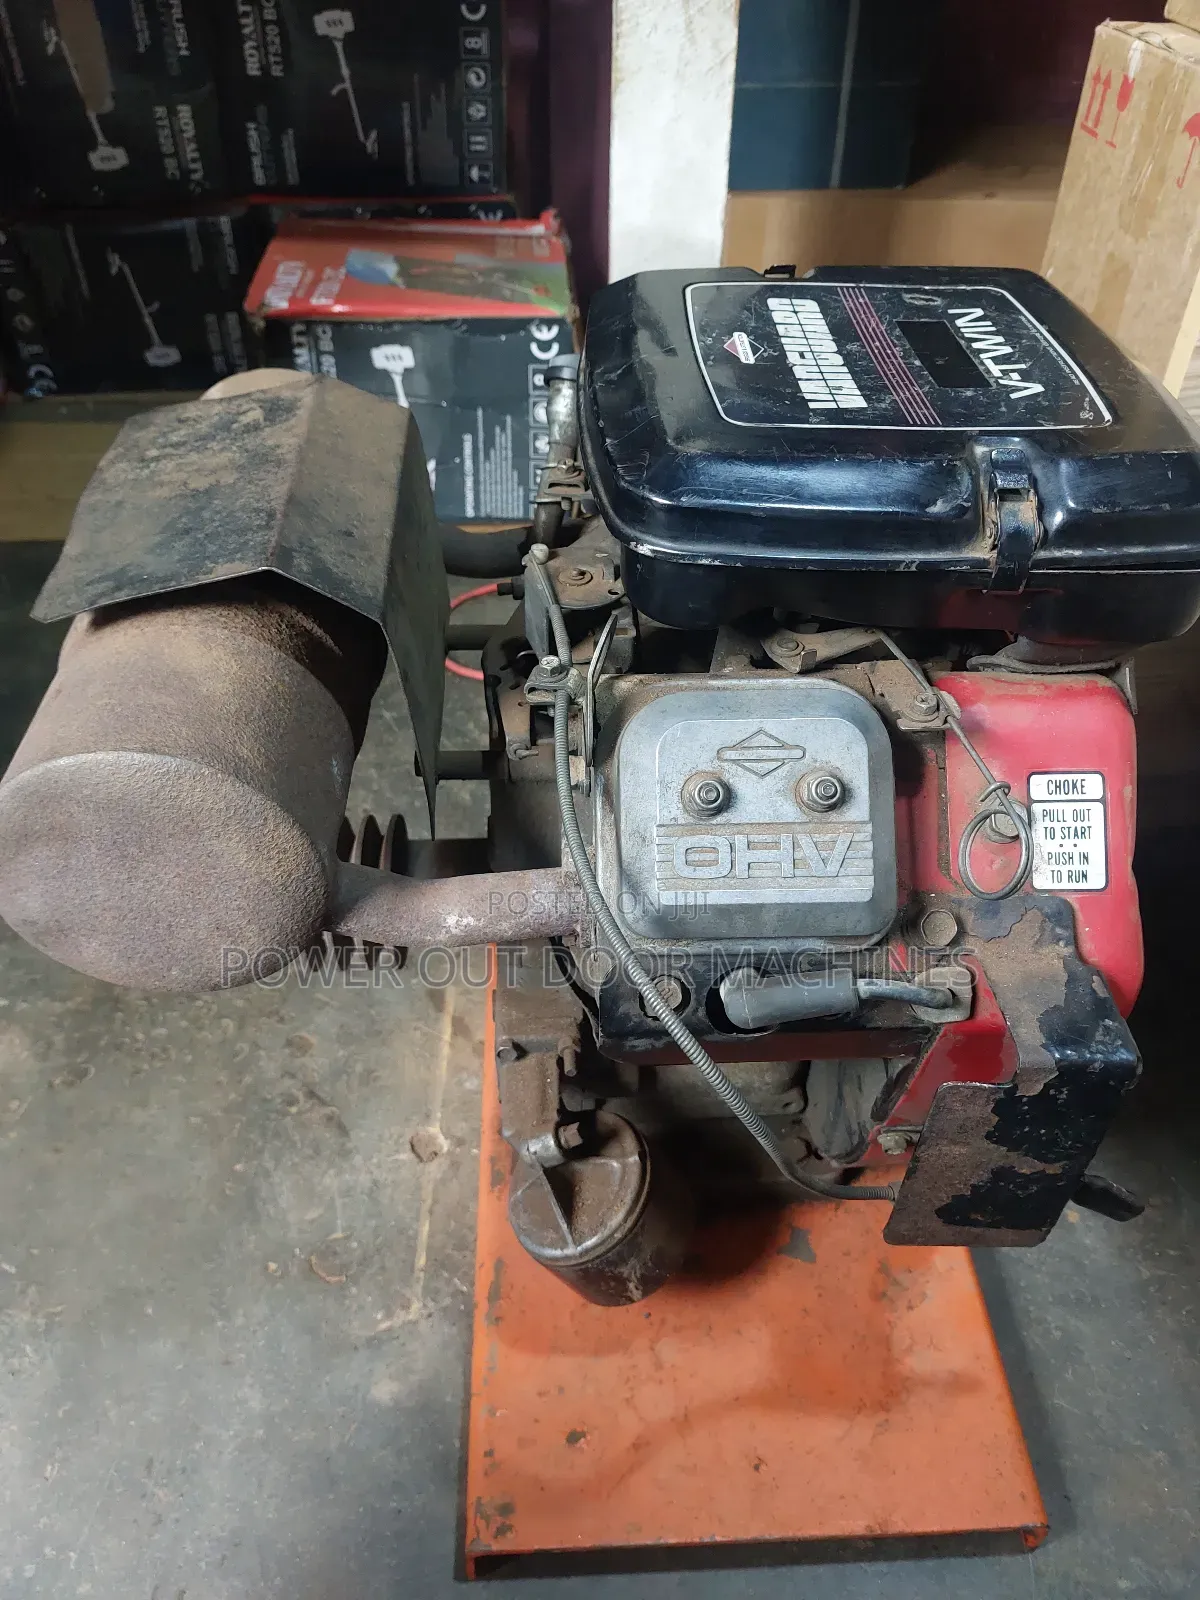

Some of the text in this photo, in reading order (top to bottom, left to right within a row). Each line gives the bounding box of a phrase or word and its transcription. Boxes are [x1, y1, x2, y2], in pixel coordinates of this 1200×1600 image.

[237, 0, 263, 76] ROYALT
[766, 297, 869, 409] VANGUARD
[947, 308, 1046, 400] V-TWIN
[1047, 778, 1087, 795] CHOKE
[1042, 808, 1092, 823] PULL OUT
[1043, 826, 1092, 840] TO START
[673, 832, 855, 880] OHV
[1047, 851, 1090, 866] PUSH IN
[1050, 869, 1088, 884] TO RUN
